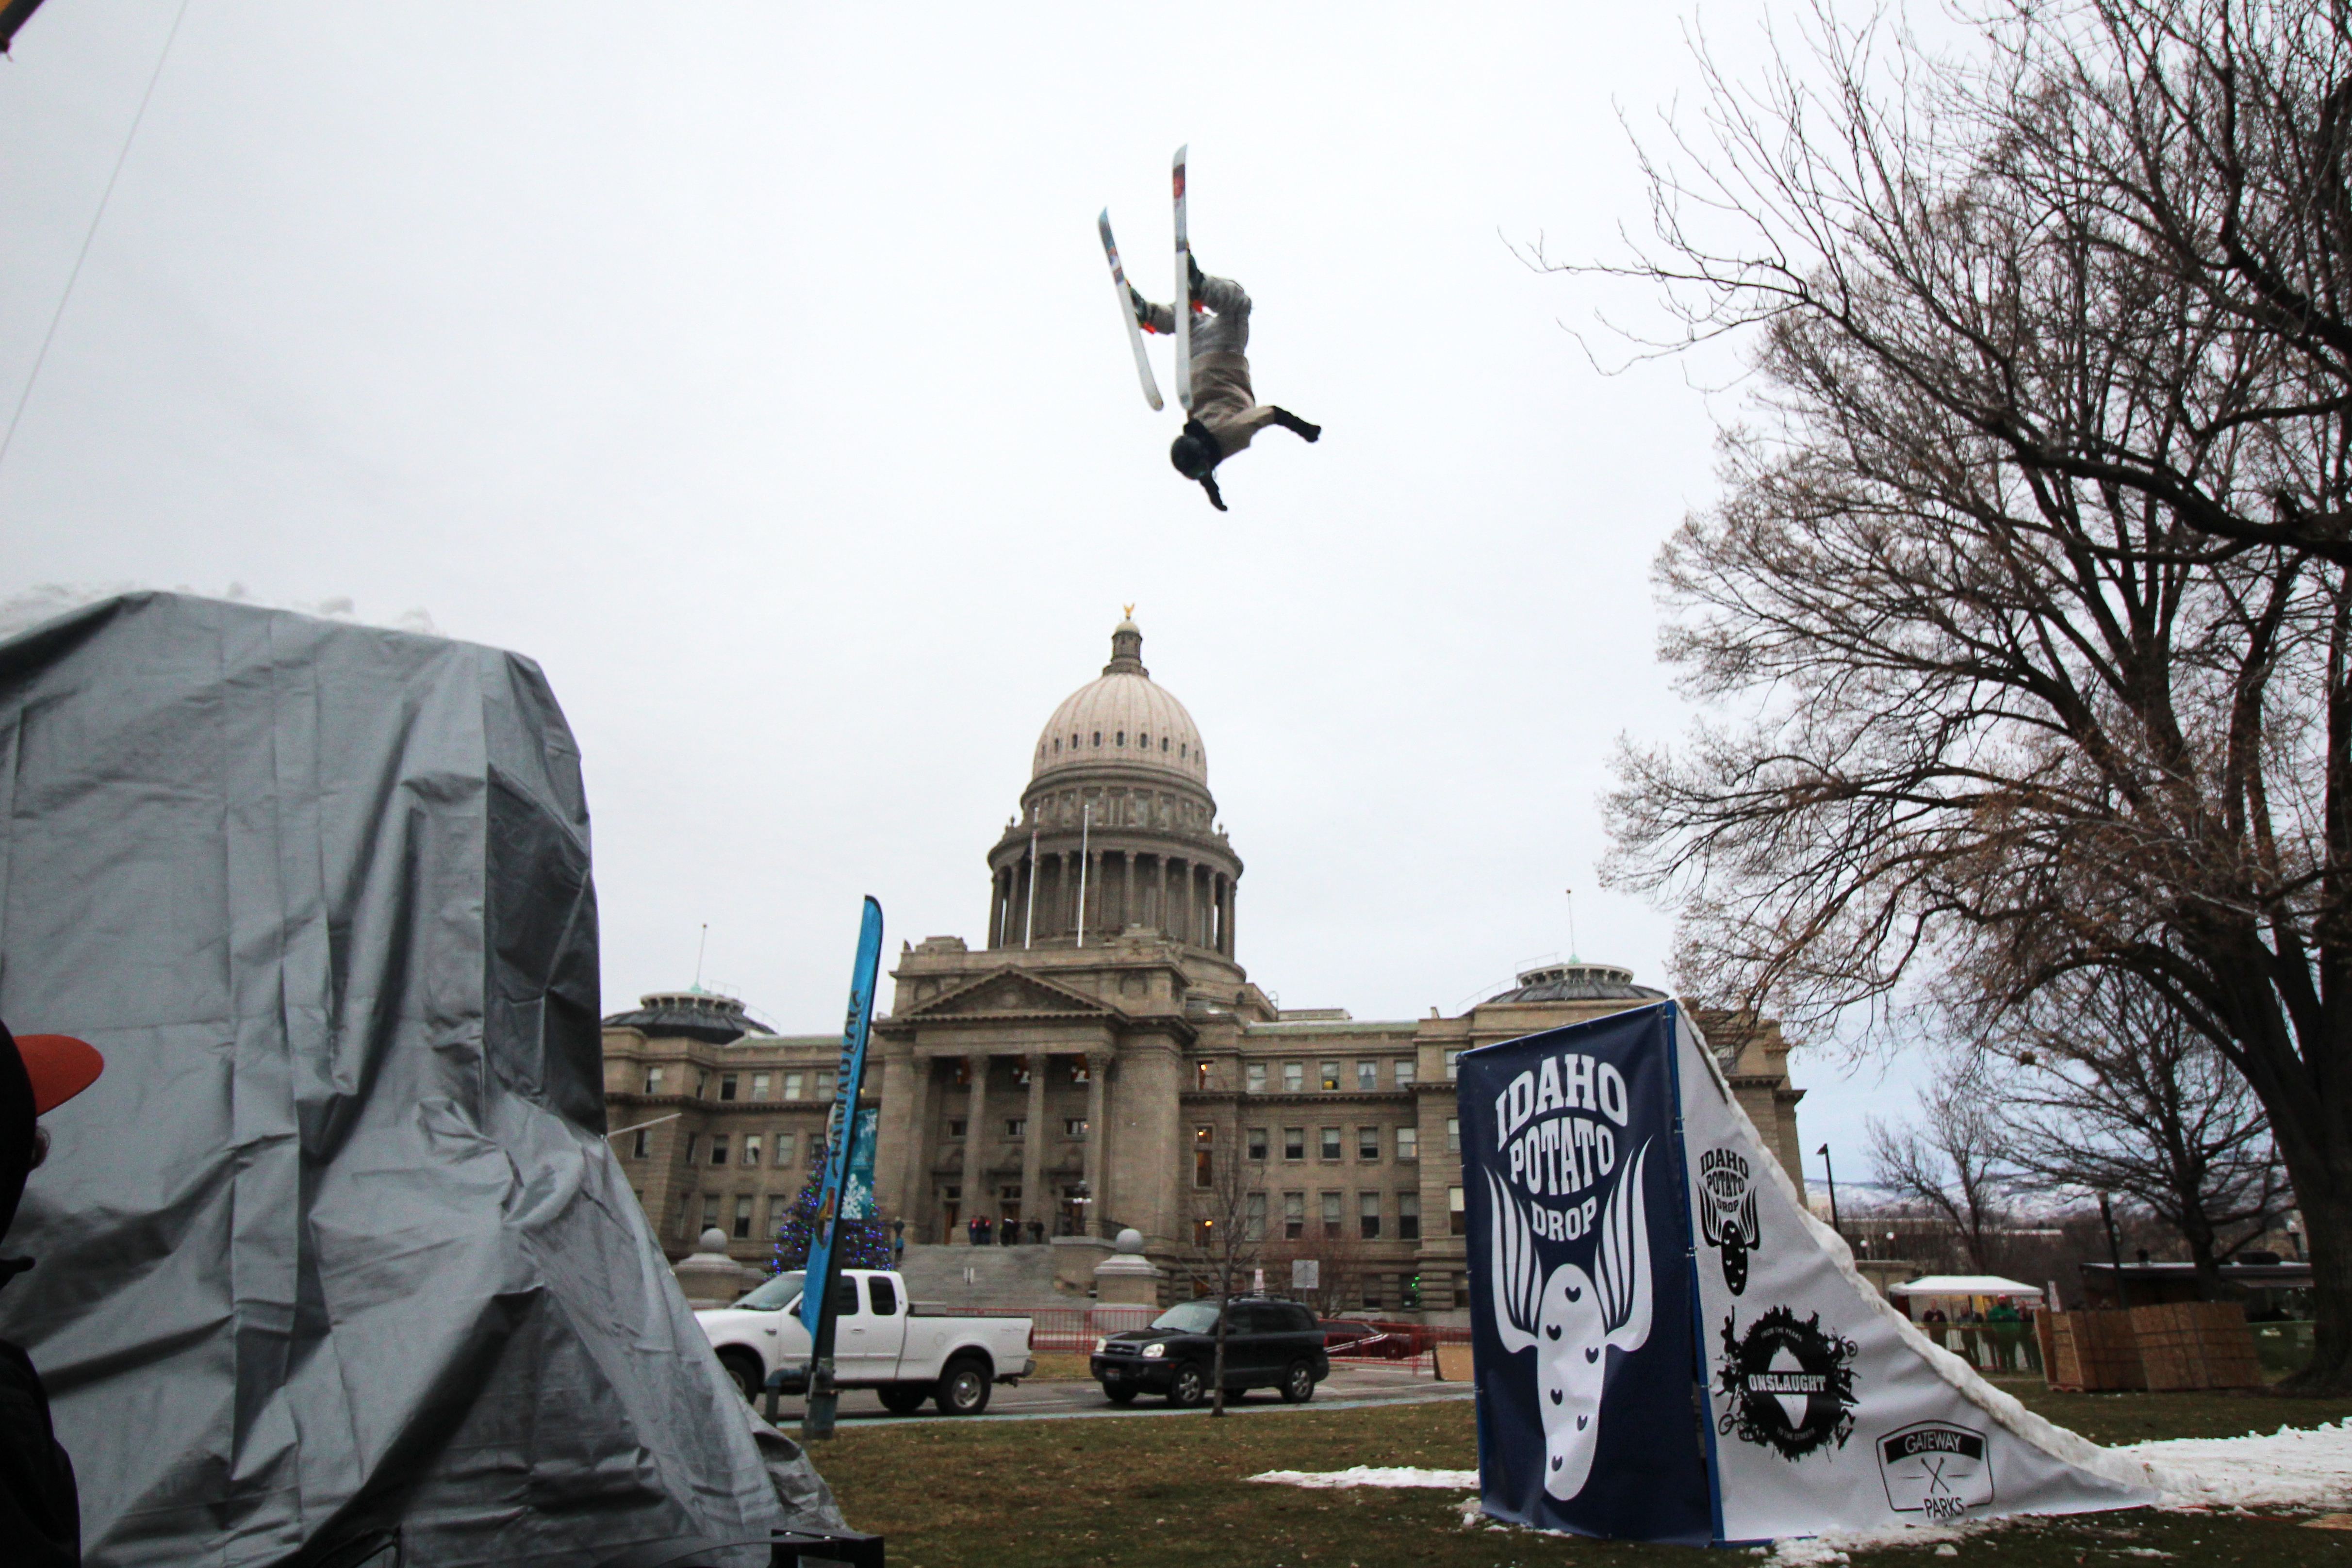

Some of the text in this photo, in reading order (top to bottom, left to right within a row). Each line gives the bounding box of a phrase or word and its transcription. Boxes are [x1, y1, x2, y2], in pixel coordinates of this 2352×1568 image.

[1495, 1053, 1628, 1152] IDAHO
[1509, 1117, 1615, 1195] POTATO
[1700, 1148, 1749, 1179] IDAHO
[1706, 1170, 1744, 1197] POTATO
[1531, 1196, 1597, 1241] DROP
[1716, 1197, 1739, 1213] DROP
[1748, 1373, 1826, 1392] ONSLAUGHT
[1905, 1432, 1961, 1454] GATEWAY
[1923, 1497, 1964, 1519] PARKS
